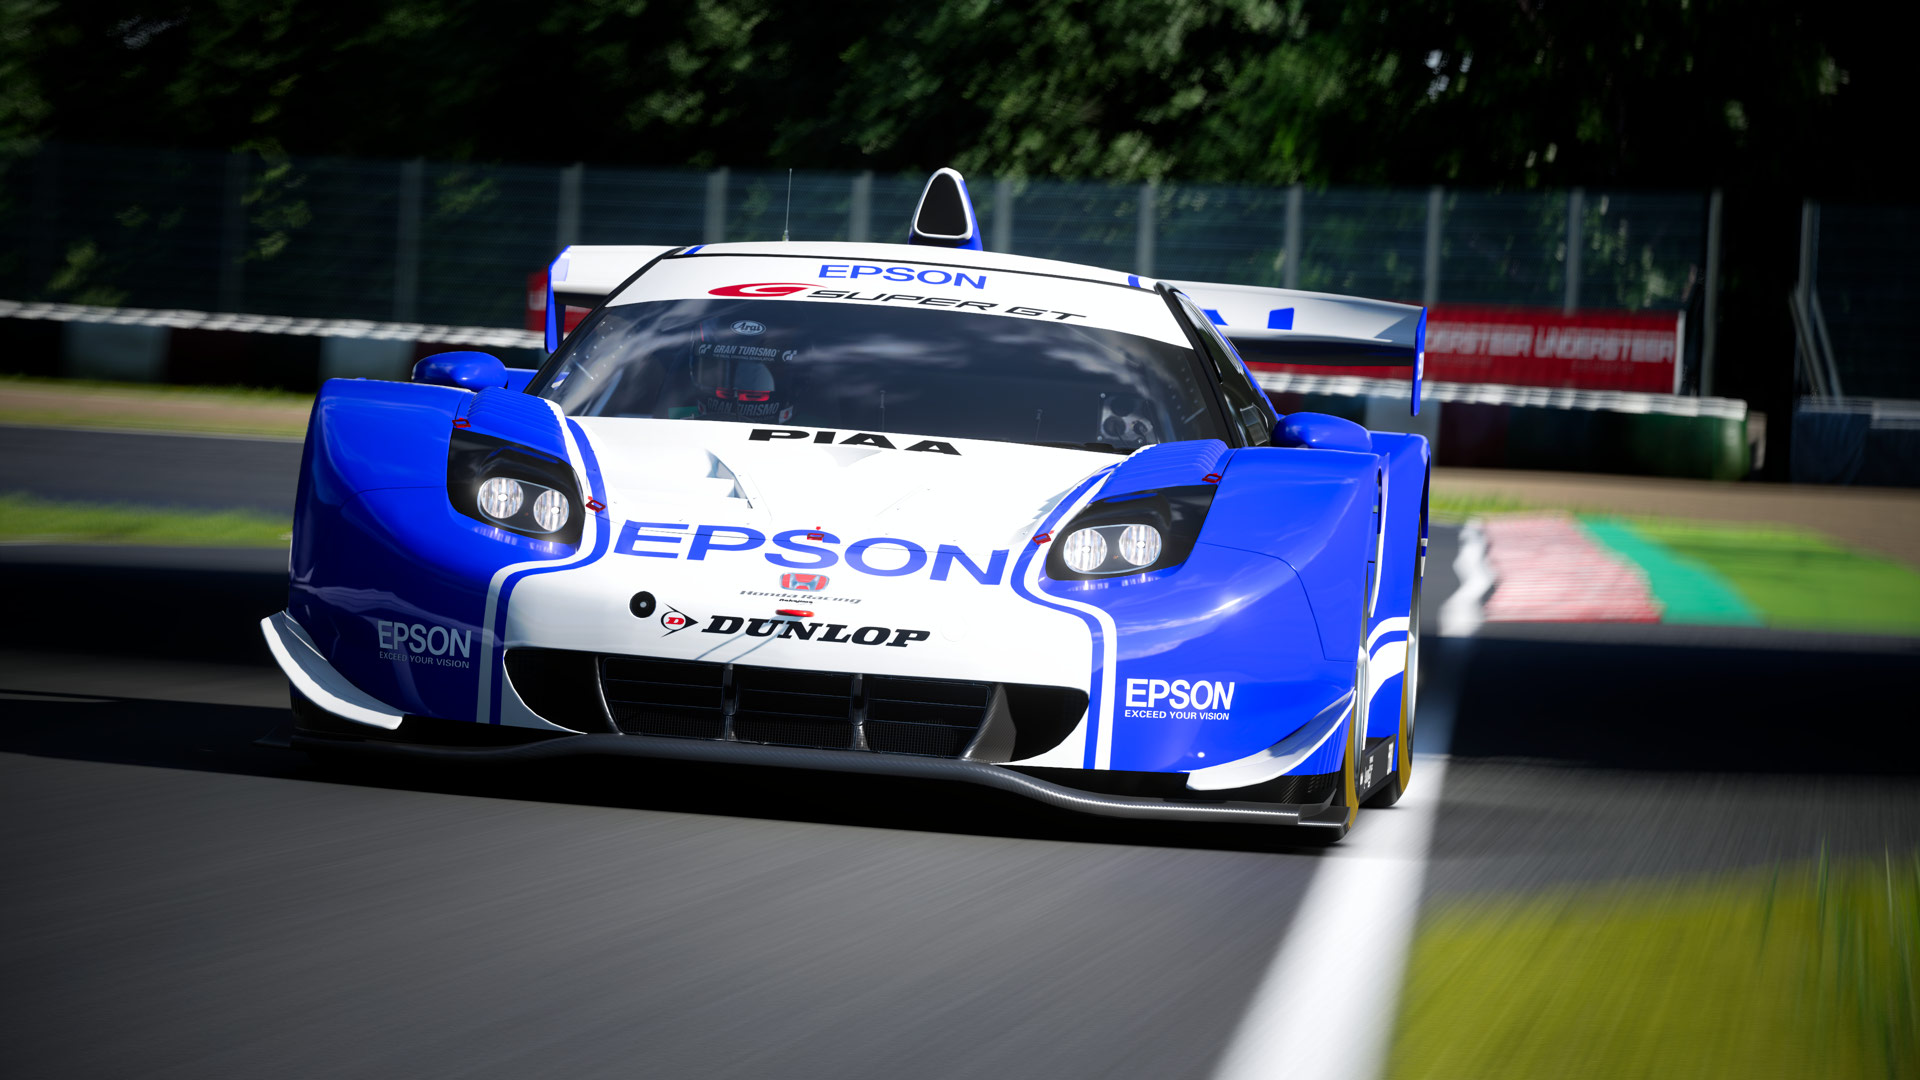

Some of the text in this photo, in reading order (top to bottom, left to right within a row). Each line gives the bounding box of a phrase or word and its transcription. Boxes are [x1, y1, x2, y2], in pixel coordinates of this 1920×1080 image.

[818, 264, 987, 290] EPSON
[806, 289, 999, 311] SUPER
[1004, 306, 1088, 321] GT
[713, 344, 737, 355] GRAN
[738, 346, 777, 358] TURISMO
[748, 428, 962, 456] PIAA
[613, 519, 1009, 585] EPSON
[378, 620, 472, 658] EPSON
[701, 614, 931, 648] DUNLOP
[379, 651, 470, 669] EXCEED YOUR VISION
[1125, 678, 1236, 710] EPSON
[1124, 709, 1230, 721] EXCEED YOUR VISION
